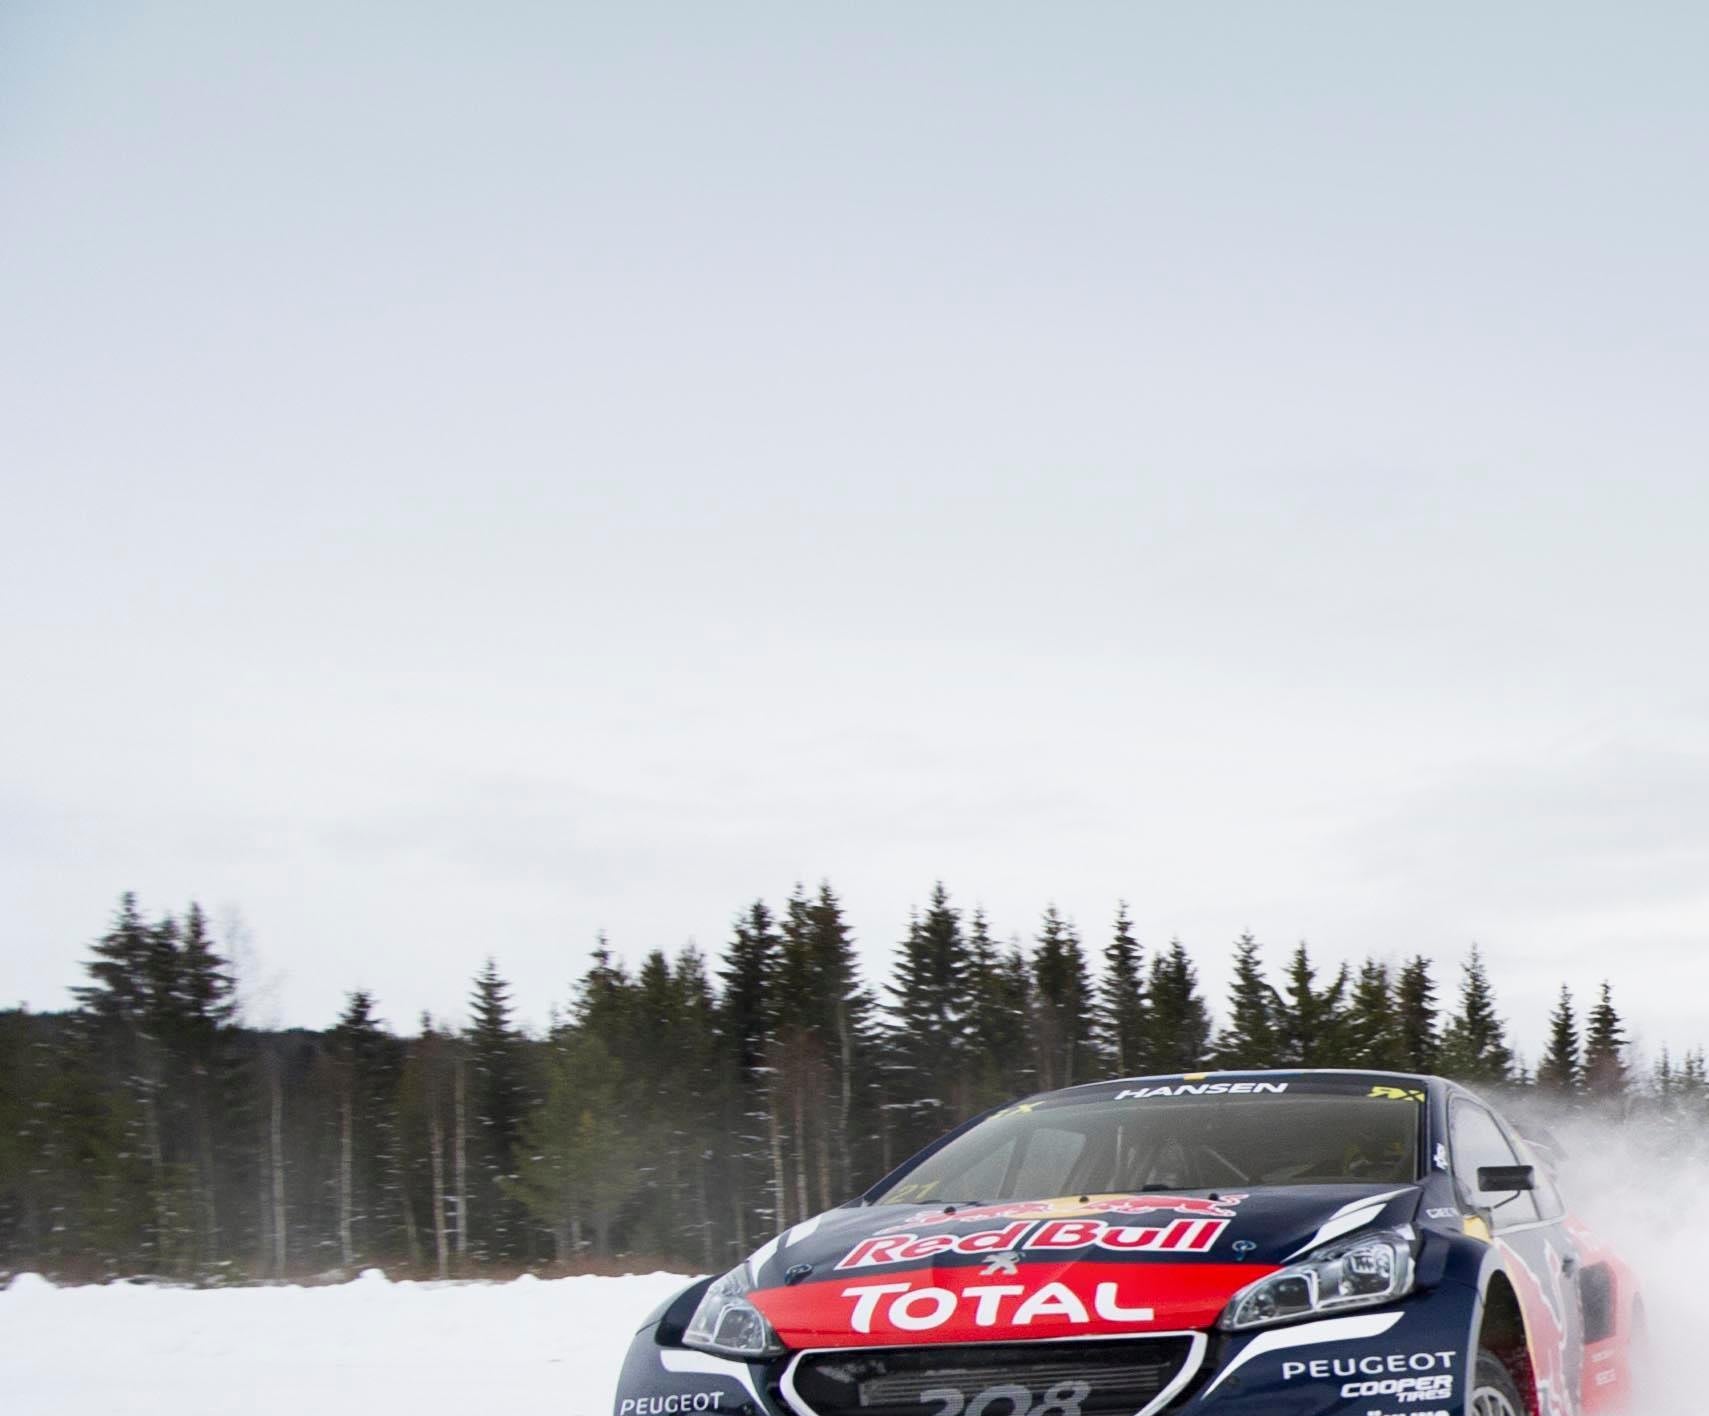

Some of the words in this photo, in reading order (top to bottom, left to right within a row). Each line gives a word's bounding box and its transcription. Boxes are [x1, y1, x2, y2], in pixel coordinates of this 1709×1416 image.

[1114, 1082, 1288, 1100] HANSEN
[834, 1219, 1038, 1271] Red
[1023, 1218, 1230, 1252] Bull
[841, 1282, 1155, 1334] TOTAL
[1282, 1351, 1456, 1380] PEUGEOT
[1340, 1375, 1453, 1398] COOPER
[1396, 1389, 1452, 1403] TIRES
[620, 1391, 725, 1416] PEUGEOT
